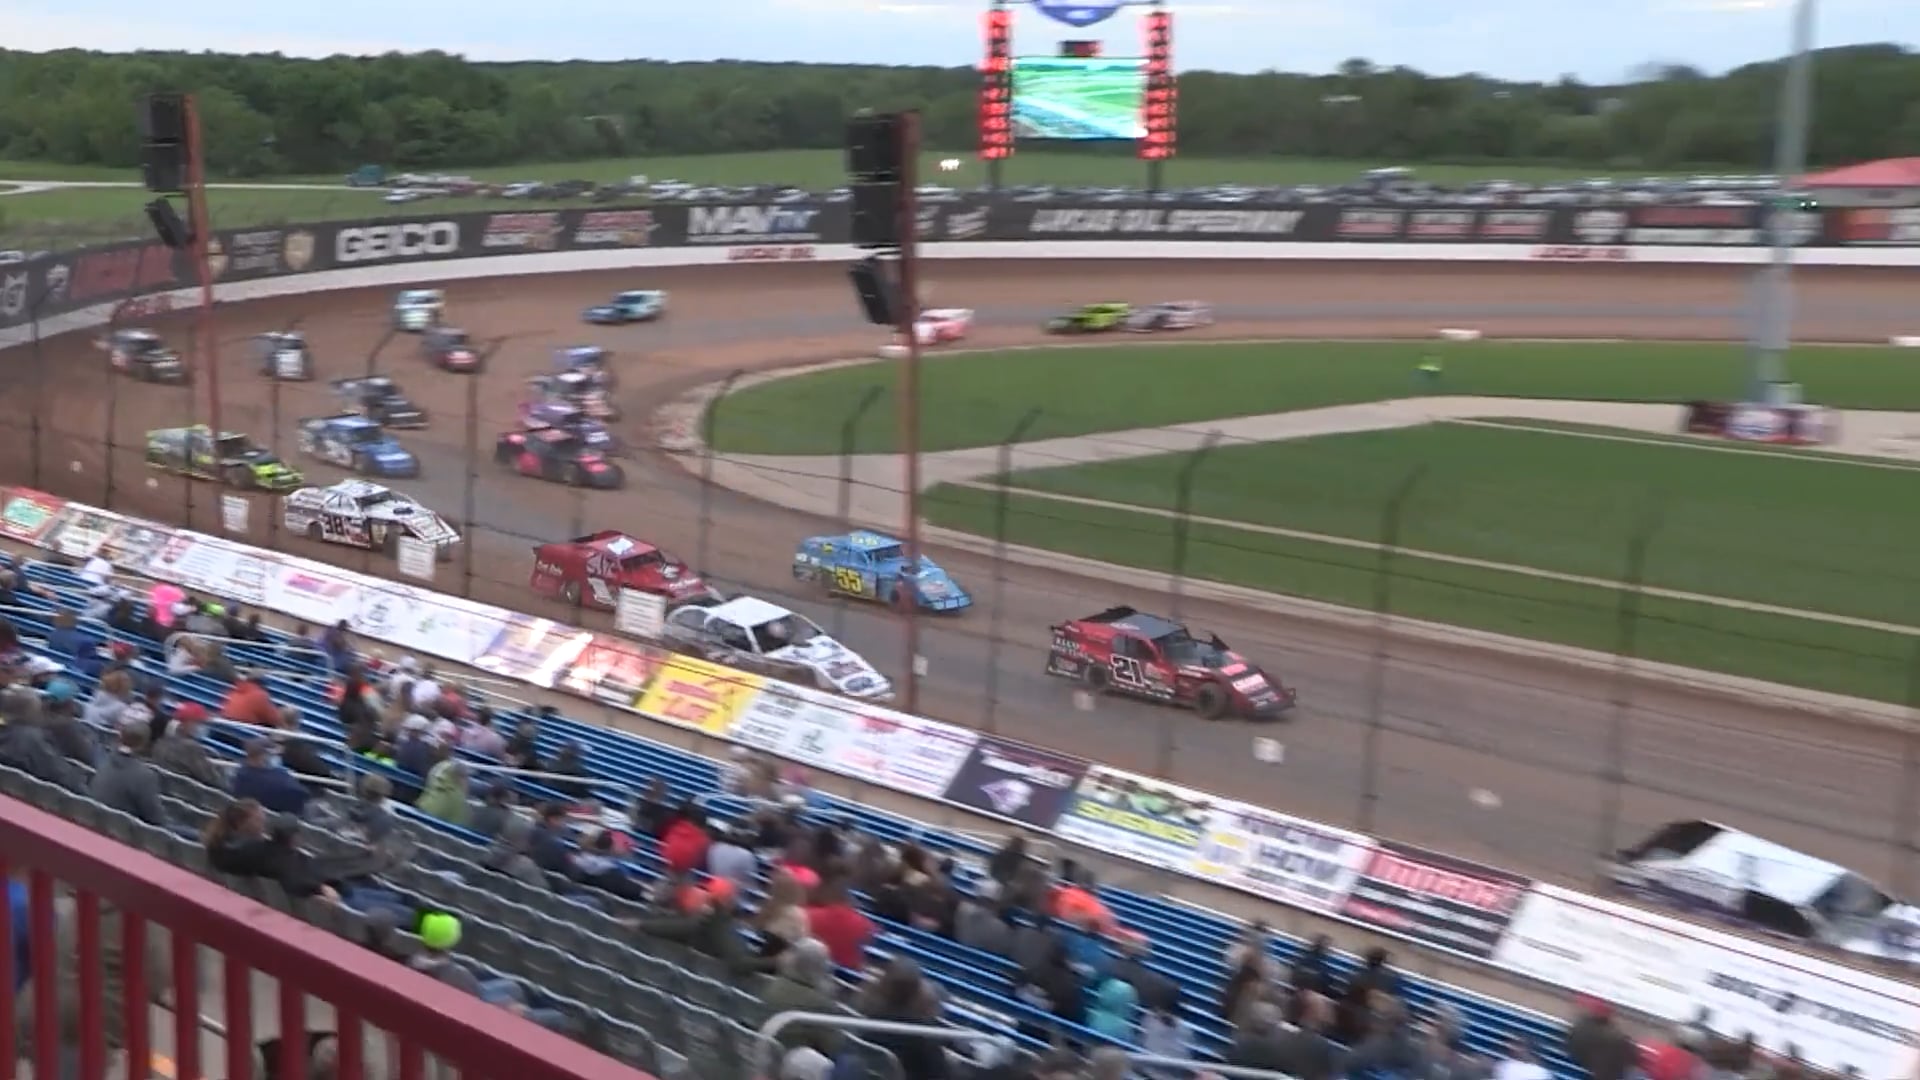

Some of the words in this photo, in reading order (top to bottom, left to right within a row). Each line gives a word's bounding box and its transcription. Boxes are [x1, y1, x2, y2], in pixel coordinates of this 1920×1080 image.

[336, 221, 460, 263] GEICO
[835, 566, 863, 594] 55
[1110, 653, 1145, 688] 21
